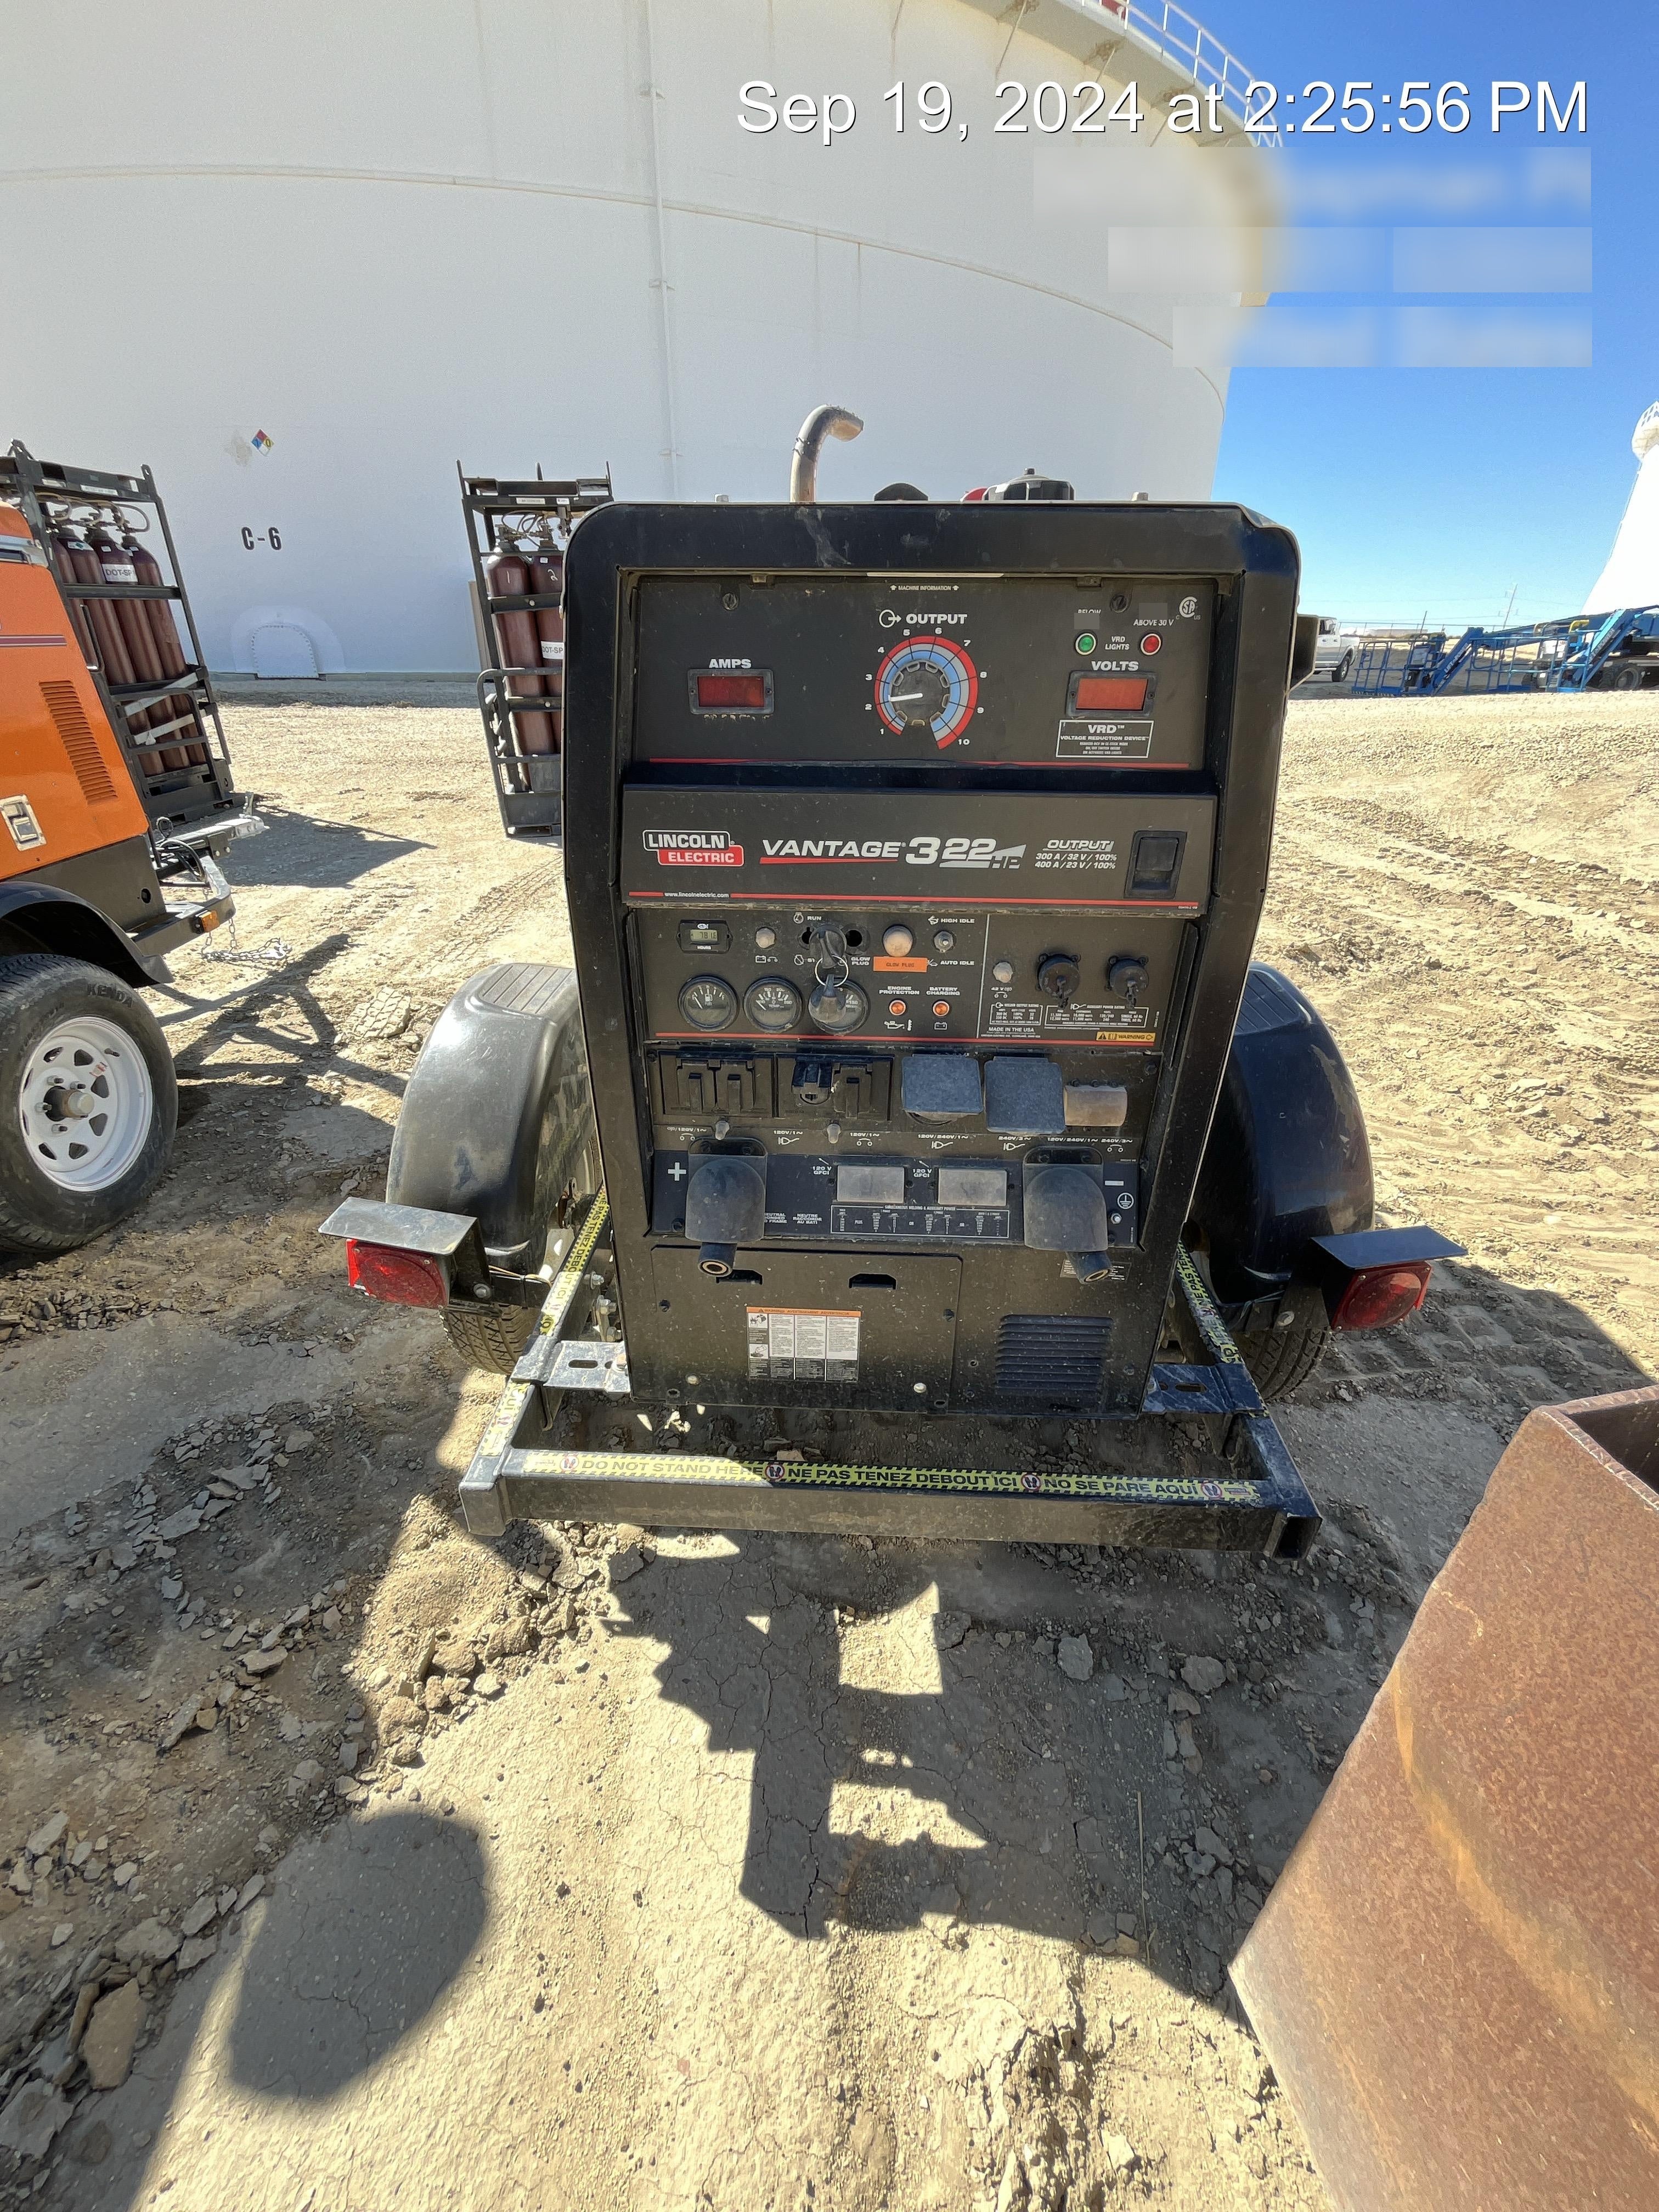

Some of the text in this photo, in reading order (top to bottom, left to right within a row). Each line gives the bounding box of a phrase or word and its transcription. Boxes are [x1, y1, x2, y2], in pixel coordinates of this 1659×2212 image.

[906, 613, 968, 624] OUTPUT
[709, 658, 752, 669] AMPS
[1091, 661, 1139, 671] VOLTS
[648, 833, 725, 849] LINCOLN
[1047, 839, 1110, 849] OUTPUT
[668, 851, 735, 864] ELECTRIC
[762, 839, 902, 857] VANTAGE
[905, 837, 997, 865] 322
[87, 983, 133, 1008] KENDA
[592, 1206, 605, 1221] PAS
[579, 1221, 598, 1248] TENEZ
[562, 1249, 585, 1285] DEBOUT
[1184, 1273, 1200, 1291] PAS
[556, 1287, 567, 1299] ICI
[582, 1460, 609, 1470] DO
[612, 1462, 650, 1471] NOT
[652, 1464, 712, 1474] STAND
[715, 1465, 765, 1476] HERE
[788, 1468, 812, 1477] NE
[816, 1469, 851, 1480] PAS
[854, 1471, 912, 1482] TENEZ
[916, 1473, 989, 1486] DEBOUT
[994, 1475, 1018, 1487] ICI
[1044, 1479, 1071, 1489] NO
[1075, 1480, 1099, 1491] SE
[1102, 1482, 1152, 1493] PARE
